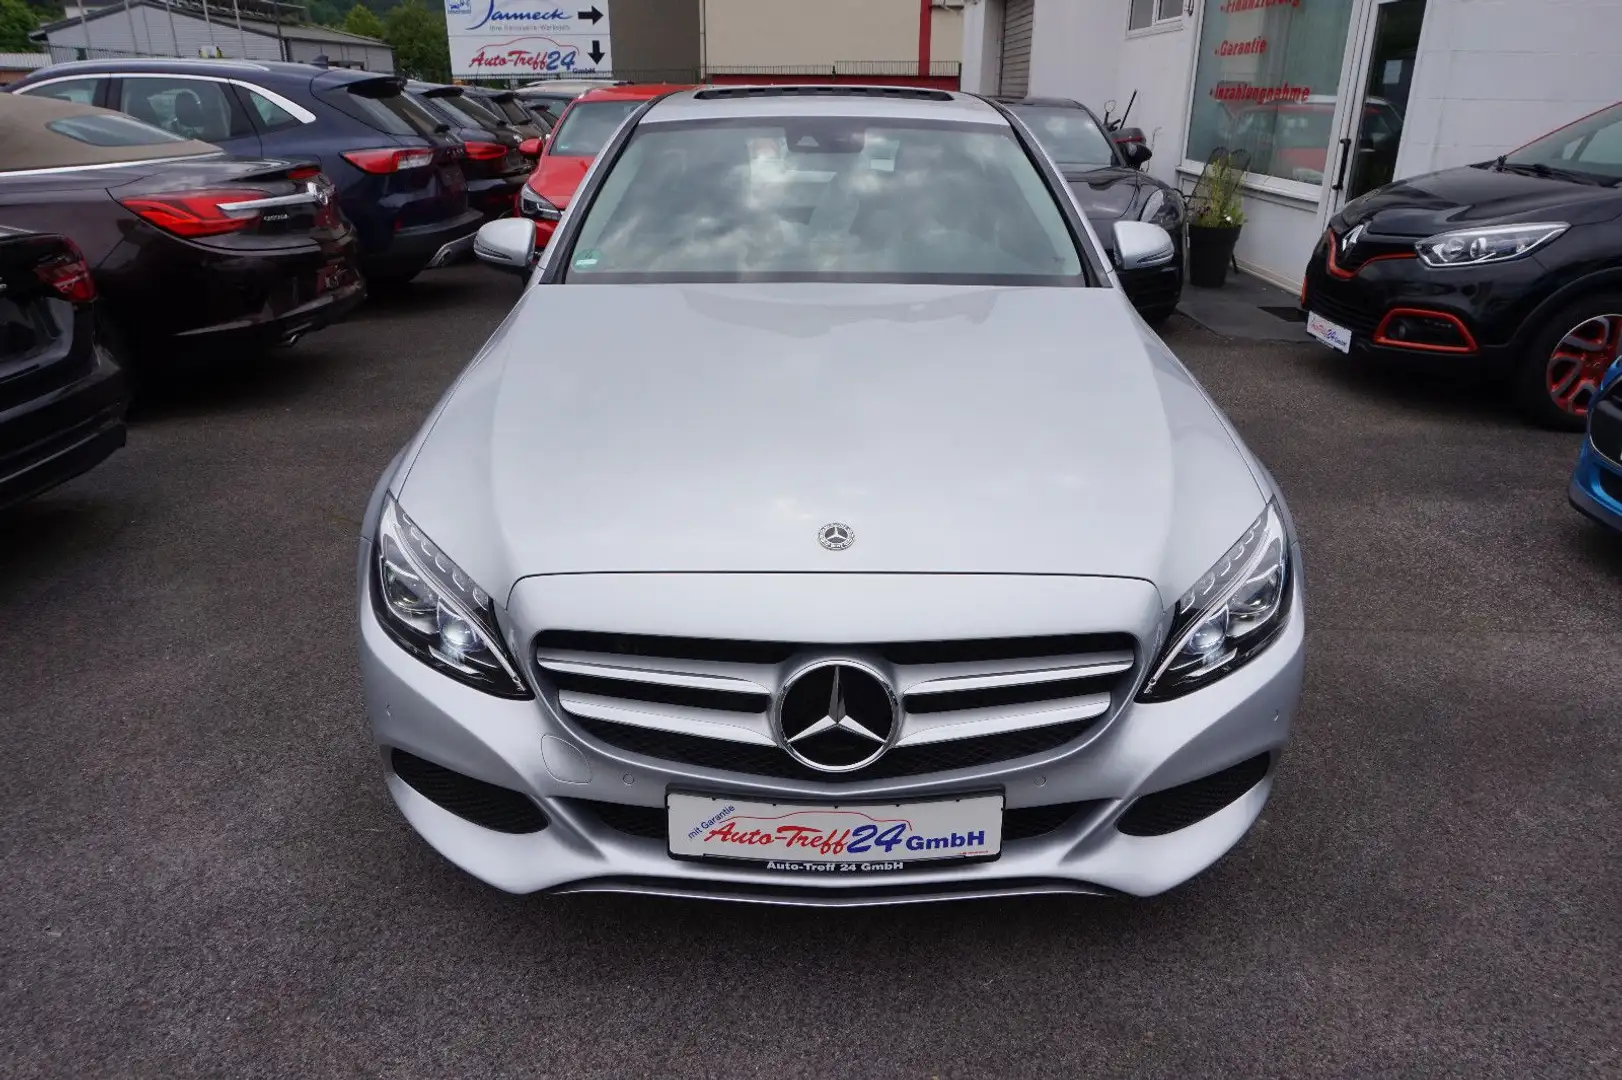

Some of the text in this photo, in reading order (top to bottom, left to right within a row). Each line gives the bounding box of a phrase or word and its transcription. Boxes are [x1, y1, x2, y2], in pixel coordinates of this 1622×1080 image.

[1220, 36, 1267, 56] Garantie
[1214, 81, 1310, 105] Inzahlungnahme
[688, 804, 736, 839] mit Garantie
[906, 830, 985, 851] GmbH
[766, 860, 904, 872] Auto-Treff 24 GmbH
